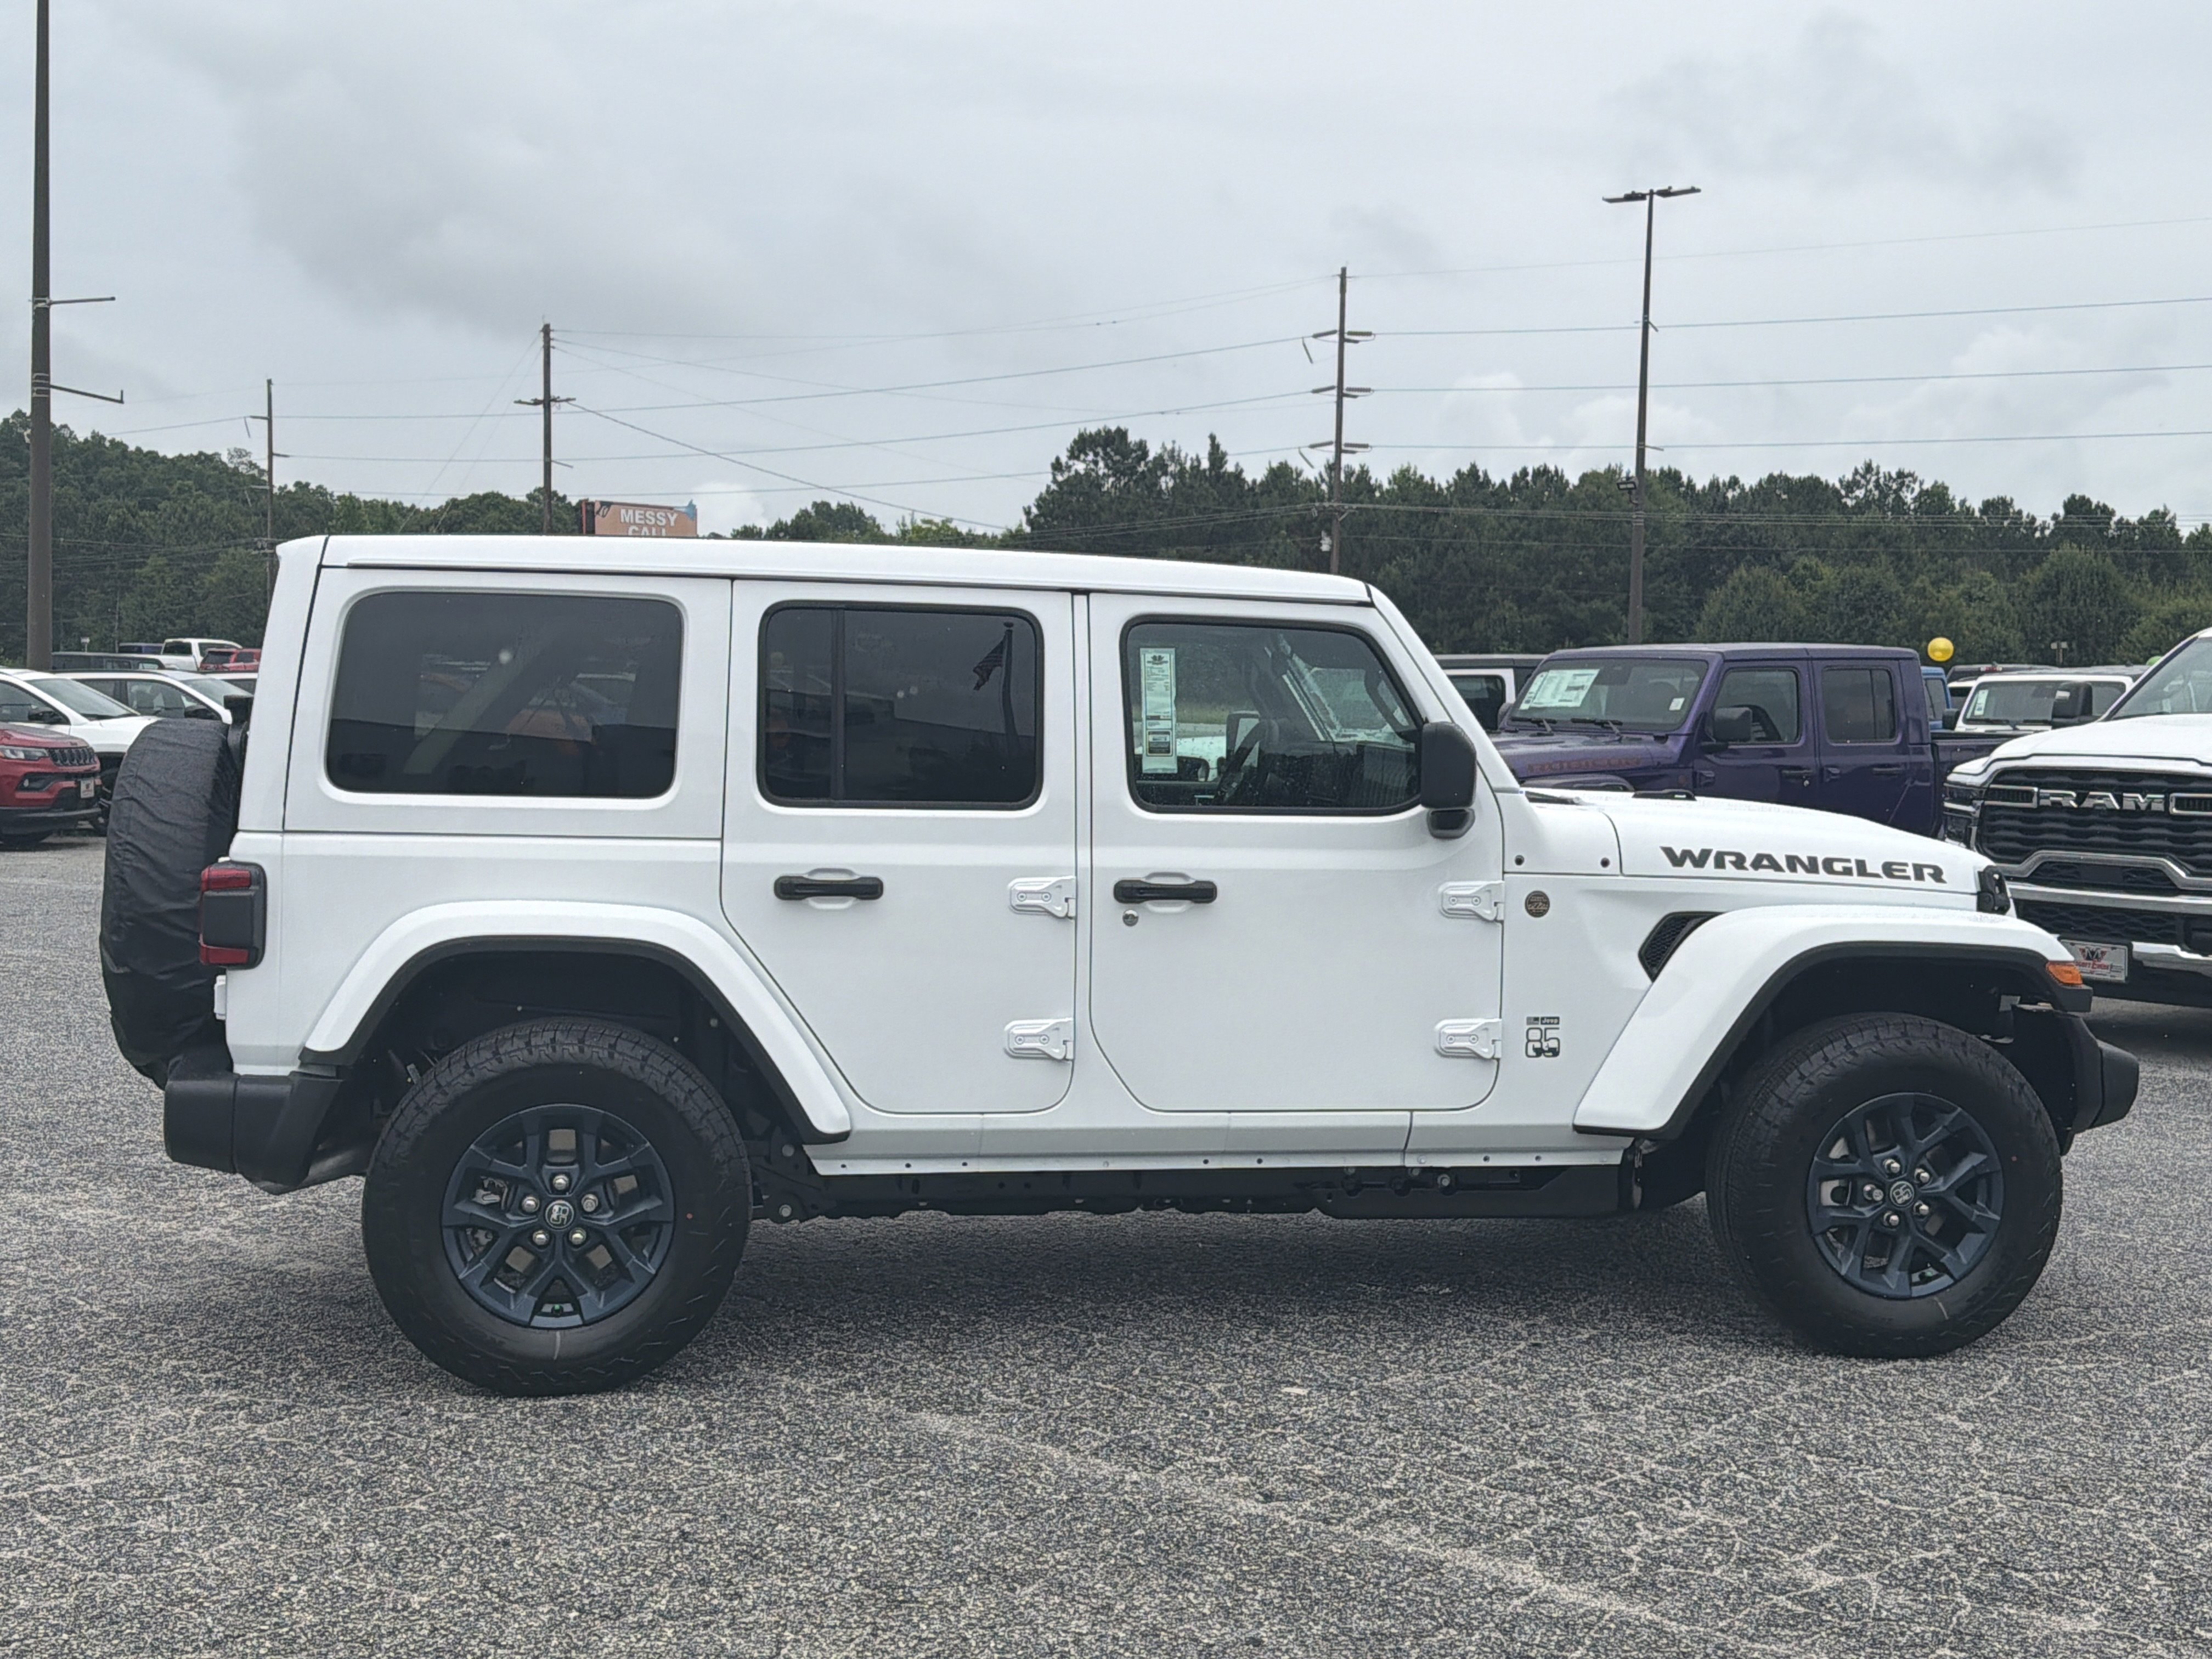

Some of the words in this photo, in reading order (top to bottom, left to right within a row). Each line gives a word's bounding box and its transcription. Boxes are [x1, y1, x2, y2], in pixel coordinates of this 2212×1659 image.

[620, 508, 679, 527] MESSY
[2039, 789, 2165, 812] RAM
[1659, 845, 1948, 884] WRANGLER
[1525, 1027, 1560, 1058] 85
